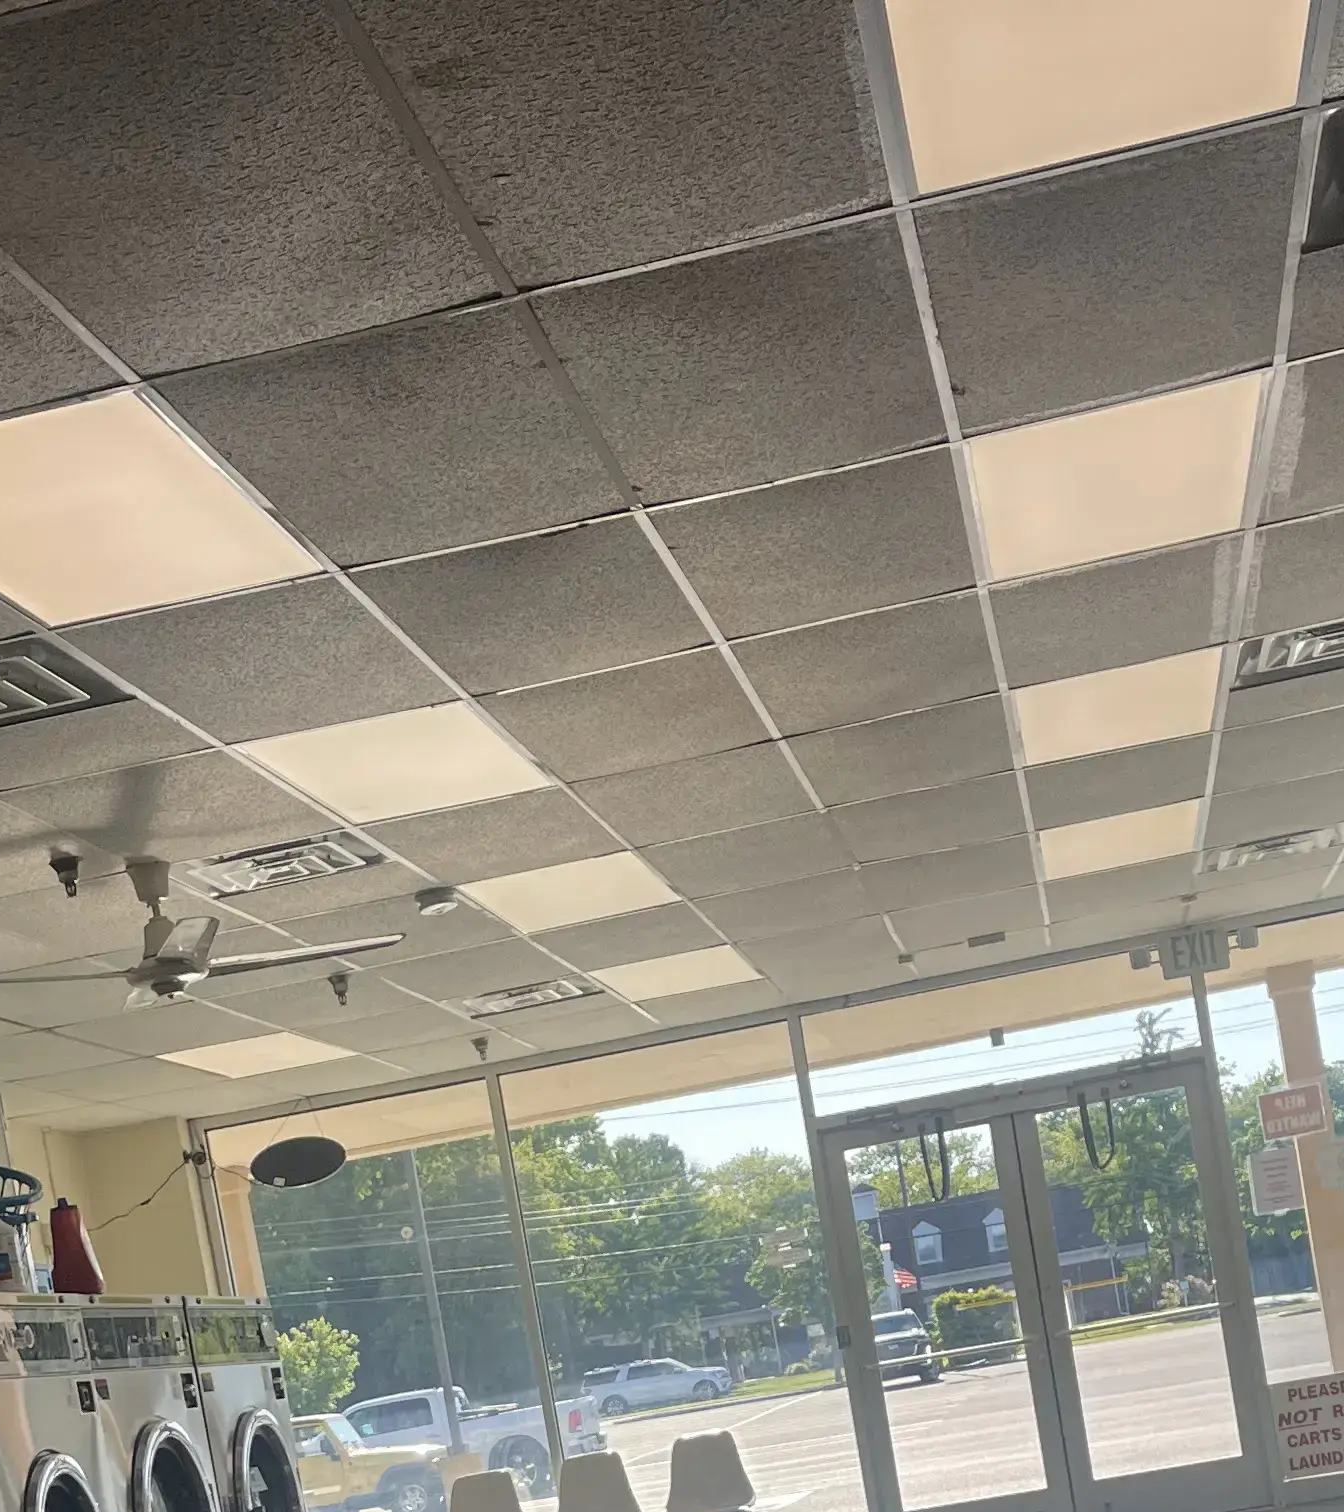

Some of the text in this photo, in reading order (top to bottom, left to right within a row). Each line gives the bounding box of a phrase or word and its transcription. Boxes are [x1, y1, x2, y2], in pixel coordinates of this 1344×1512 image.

[1170, 929, 1217, 970] EXIT
[1278, 1407, 1322, 1428] NOT
[1287, 1428, 1342, 1447] CARTS
